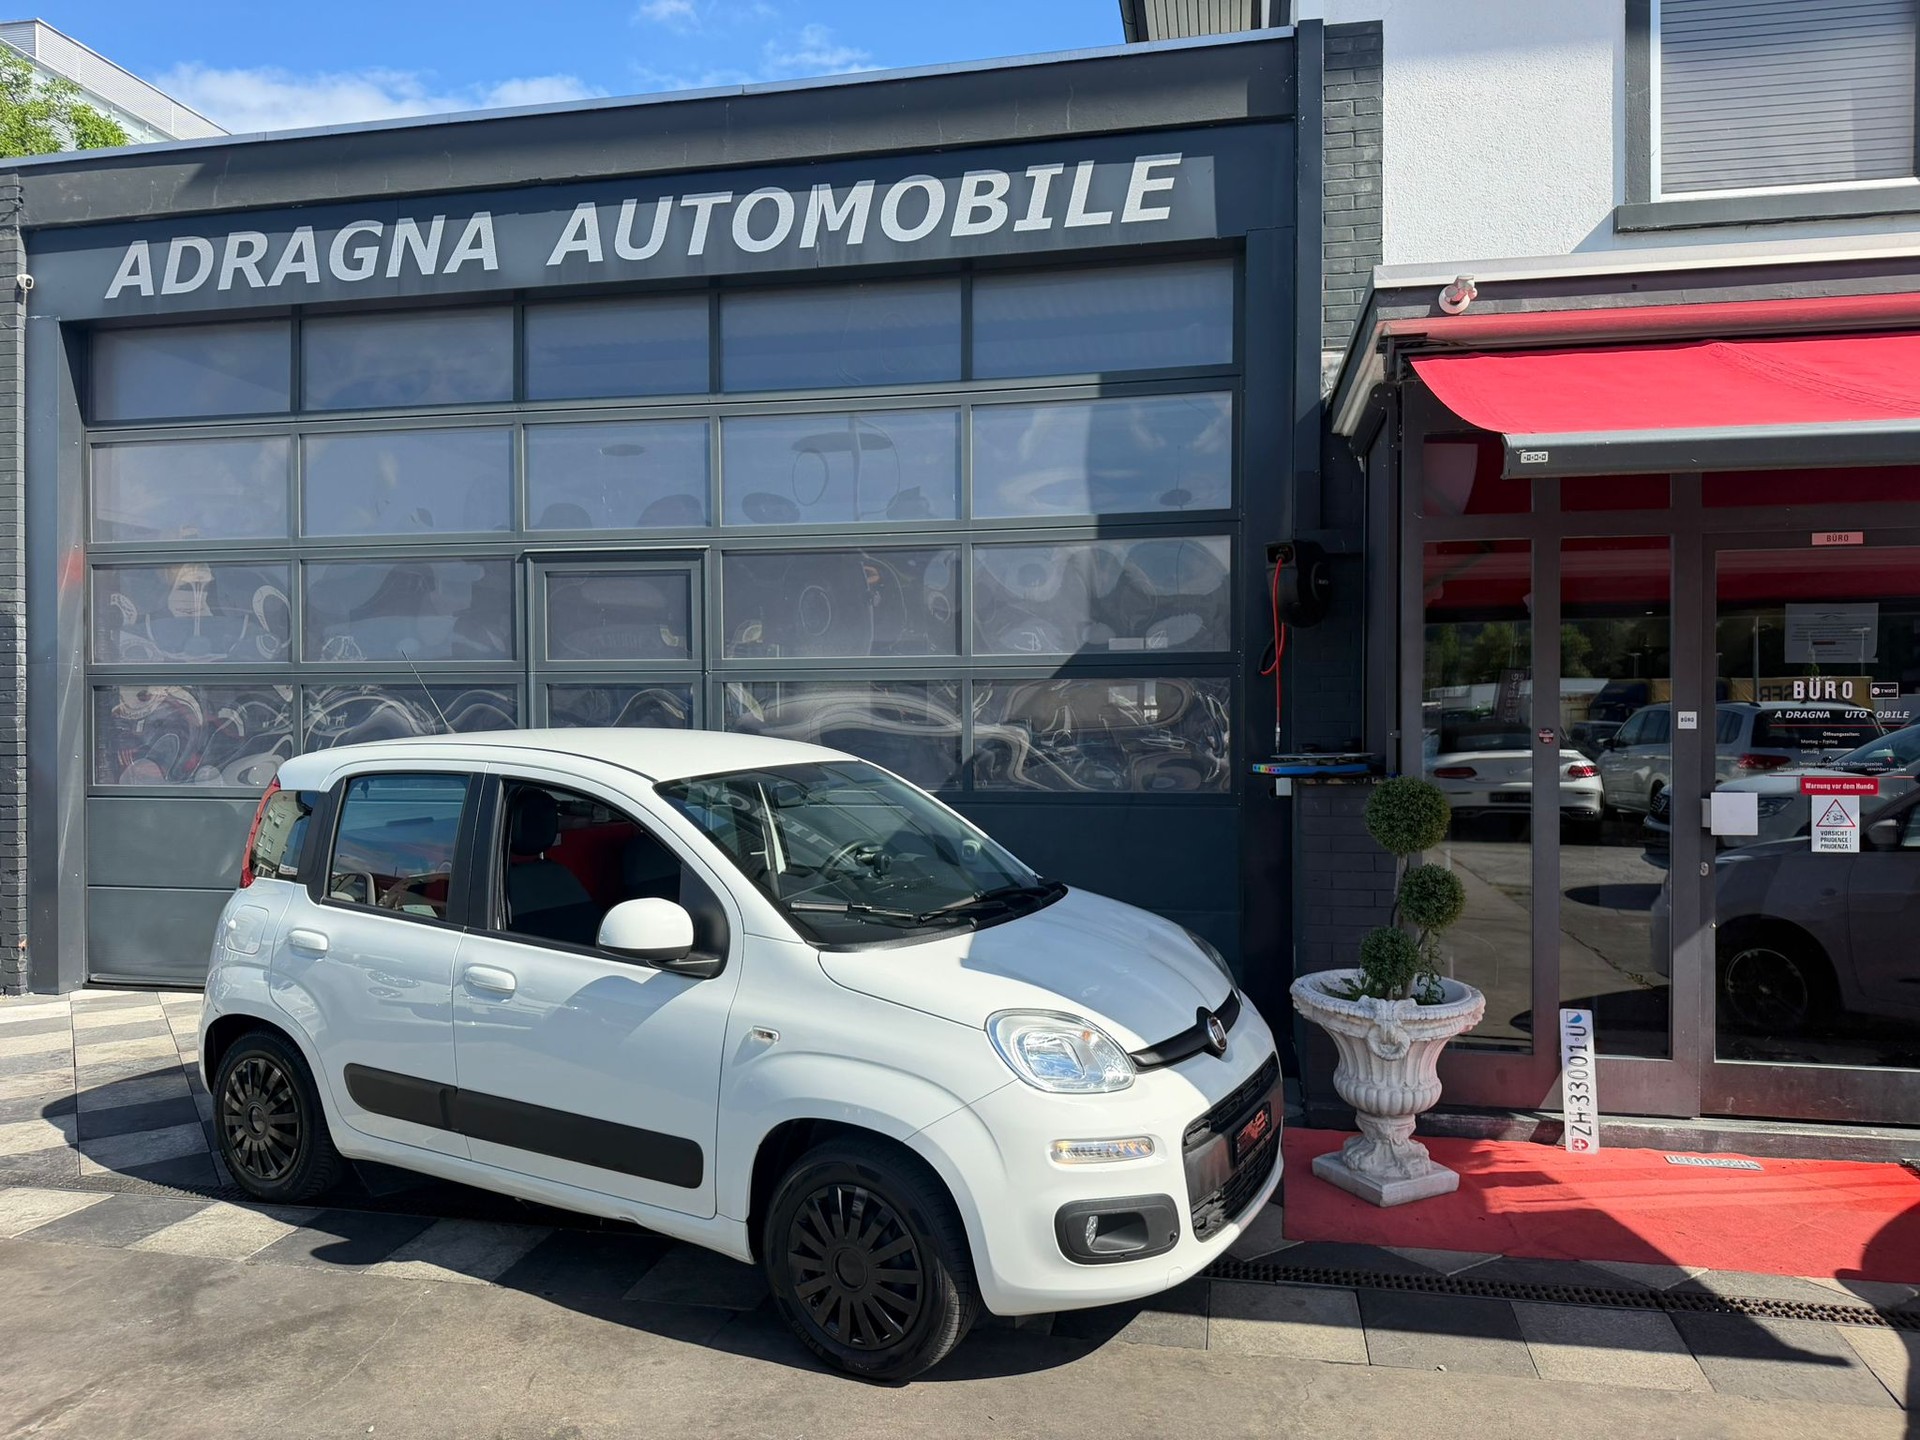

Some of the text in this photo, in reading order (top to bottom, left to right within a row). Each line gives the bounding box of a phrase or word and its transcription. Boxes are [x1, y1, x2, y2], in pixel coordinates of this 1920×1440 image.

[105, 152, 1183, 299] ADRAGNA AUTOMOBILE
[1826, 534, 1849, 542] BÜRO
[1793, 678, 1853, 699] BÜRO
